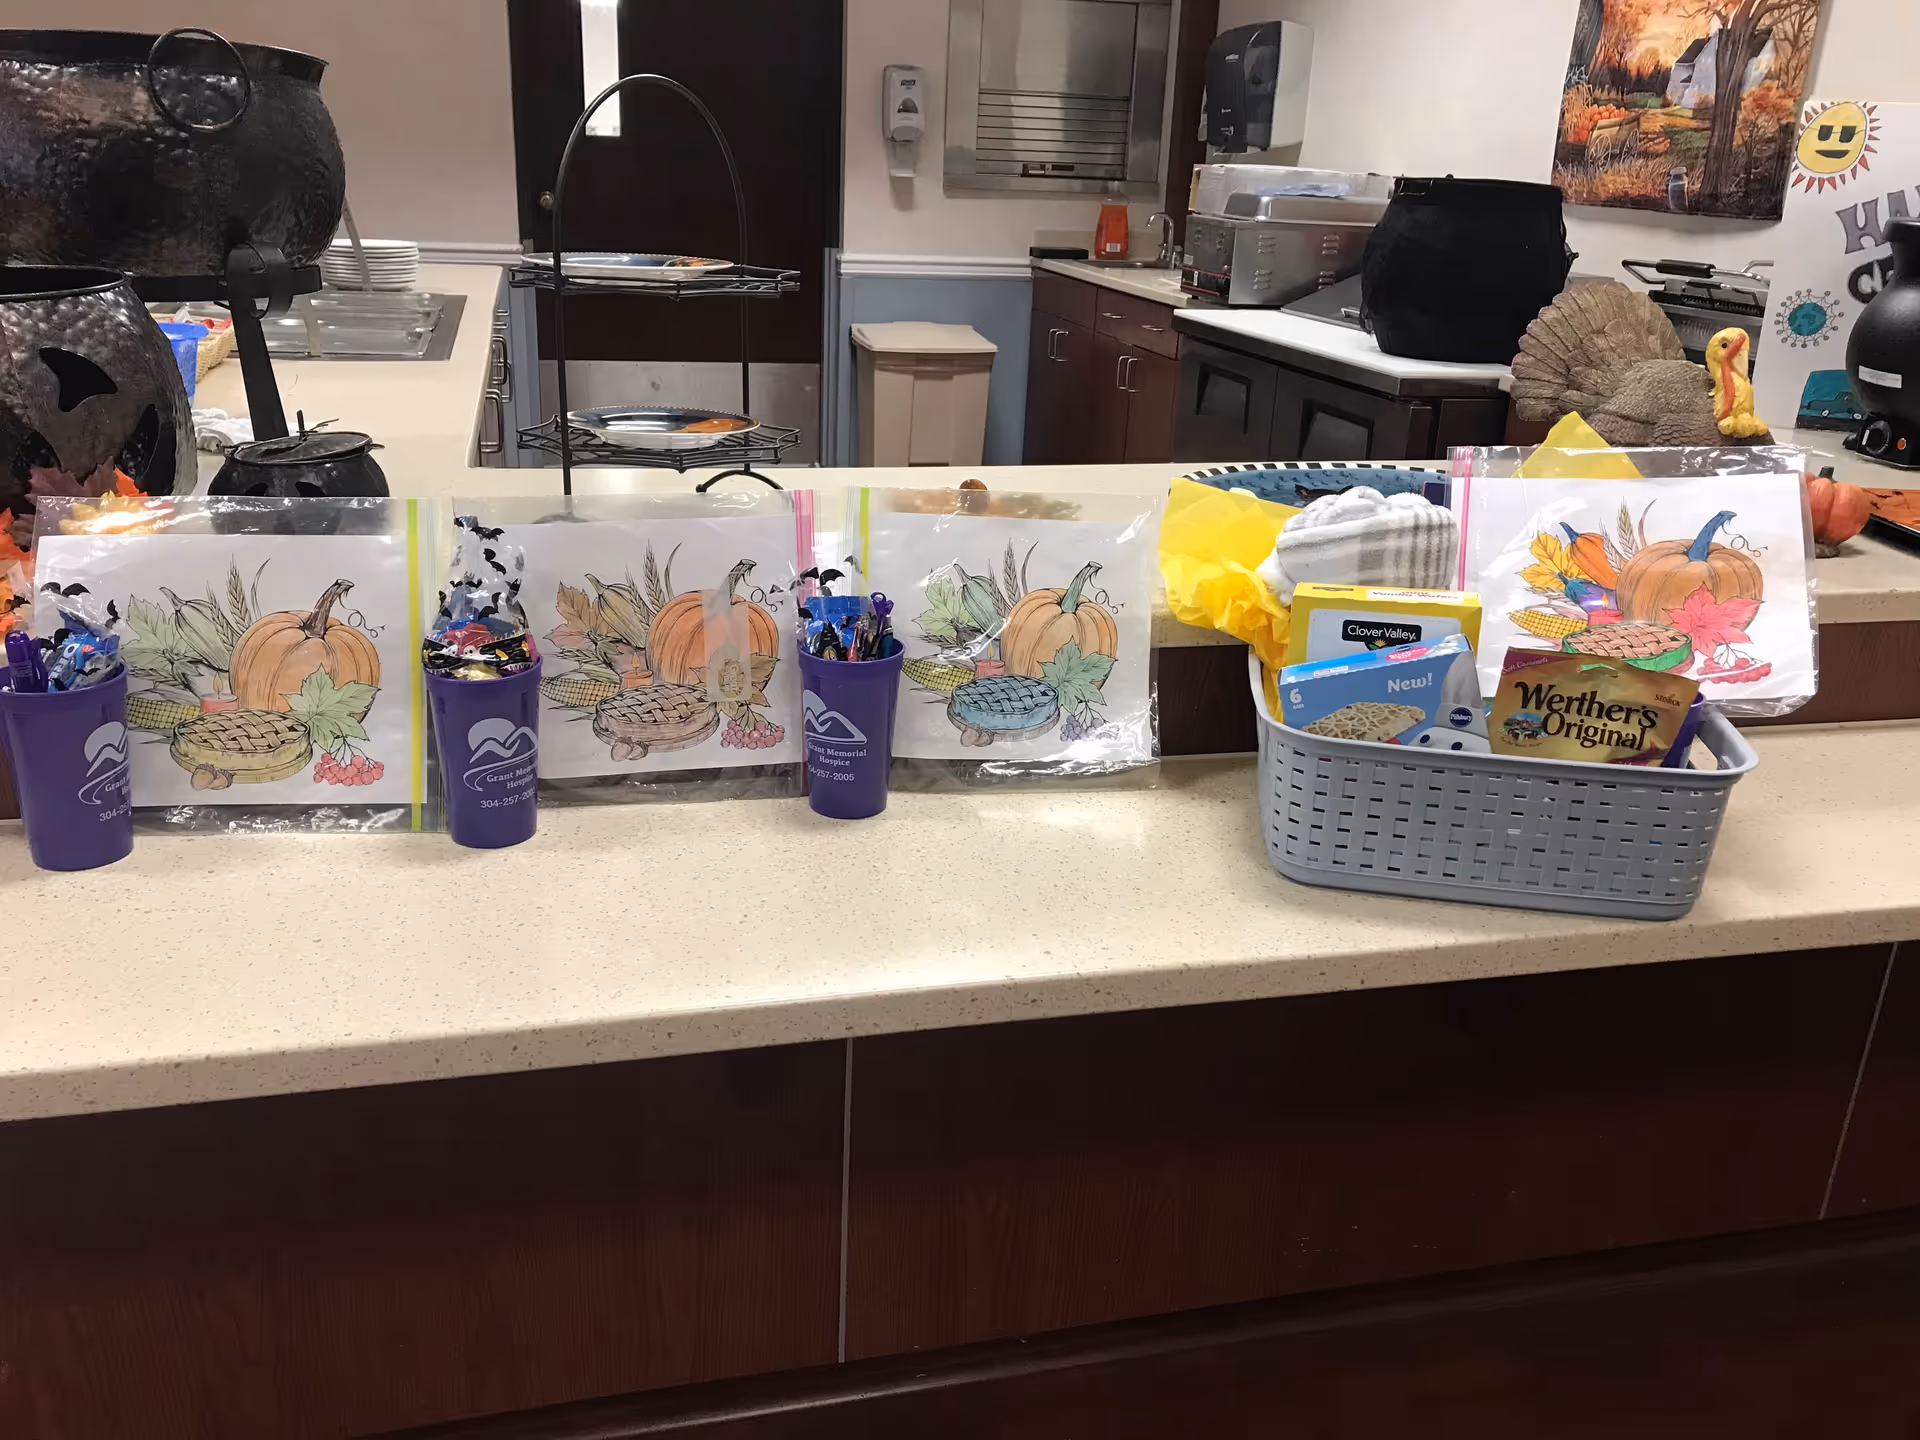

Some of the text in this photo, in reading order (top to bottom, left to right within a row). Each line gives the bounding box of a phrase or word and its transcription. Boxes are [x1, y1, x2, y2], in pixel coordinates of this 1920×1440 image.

[1347, 624, 1414, 642] Clover Valley
[1387, 673, 1433, 693] New!
[1289, 688, 1302, 704] 6
[1514, 681, 1660, 729] Werther's
[1543, 711, 1648, 752] Original
[819, 755, 851, 767] Hospice
[827, 749, 867, 758] Memorial
[105, 778, 127, 792] Grant
[486, 772, 514, 783] Grant
